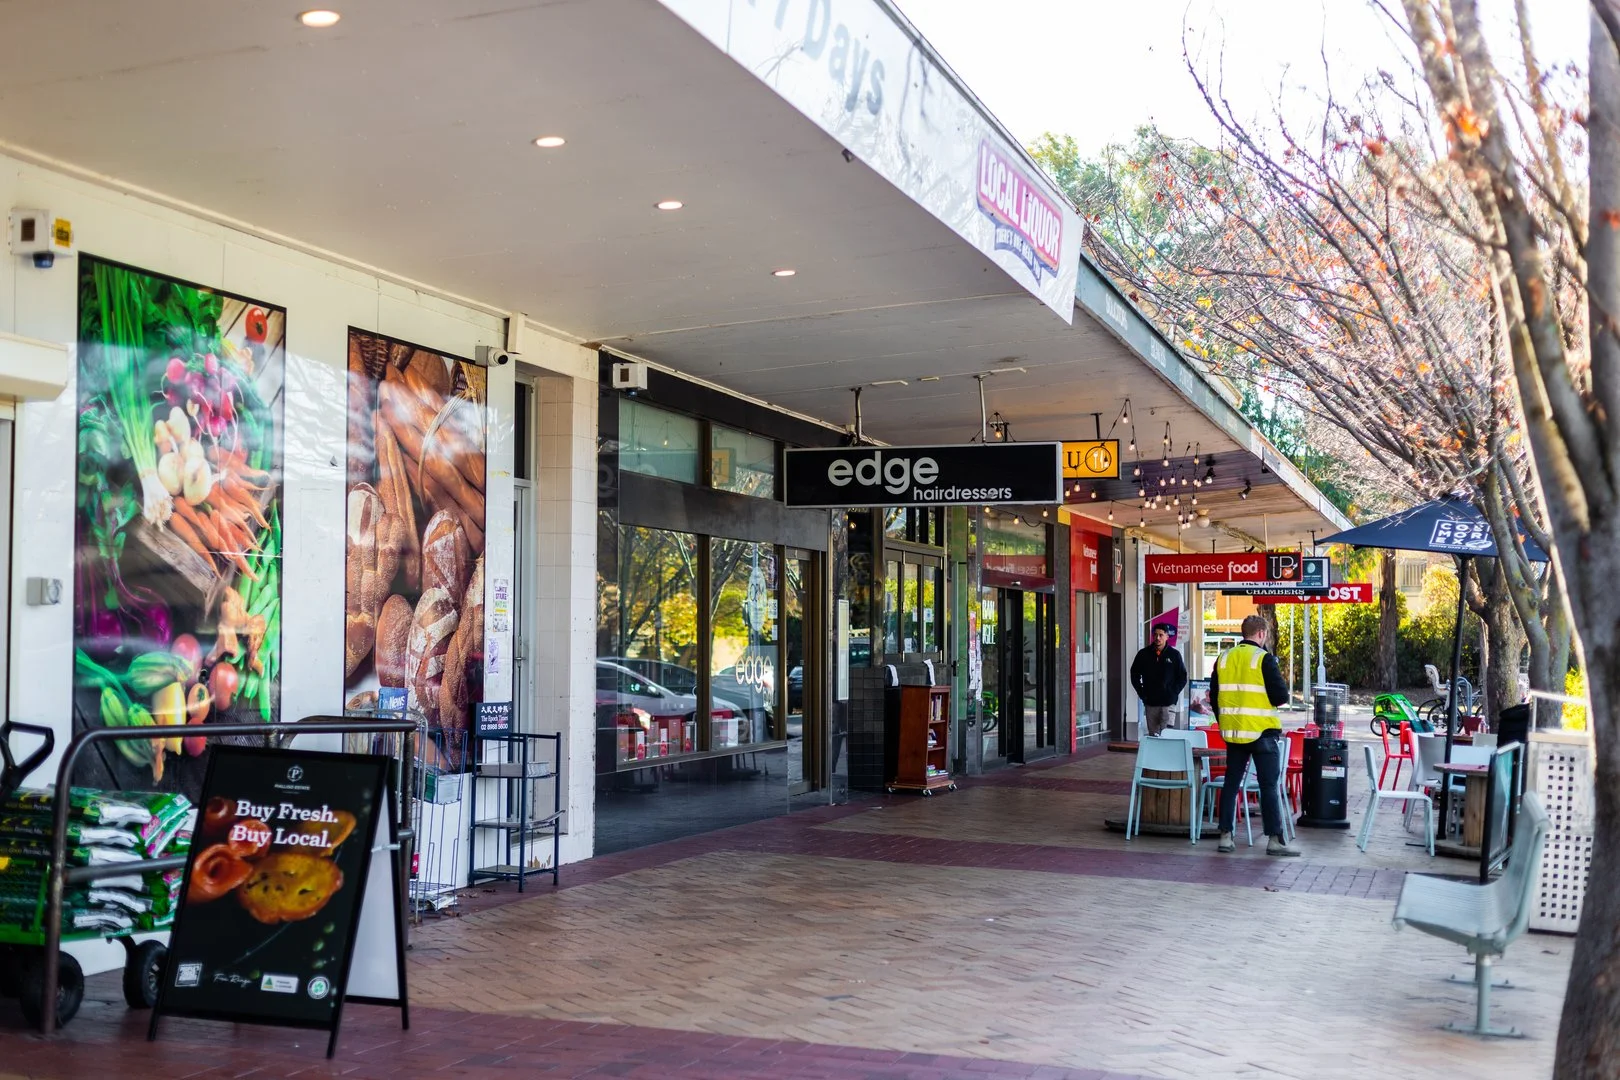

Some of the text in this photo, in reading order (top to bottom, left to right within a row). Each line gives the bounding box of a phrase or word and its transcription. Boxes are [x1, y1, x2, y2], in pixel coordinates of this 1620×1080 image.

[803, 0, 885, 115] Days
[980, 145, 1019, 226] LOCAL
[827, 450, 939, 495] edge
[913, 485, 1012, 501] hairdressers
[1152, 560, 1259, 581] Vietnamese food
[1246, 588, 1305, 596] CHAMBERS
[234, 800, 339, 823] Buy Fresh.
[231, 825, 332, 848] Buy Local.
